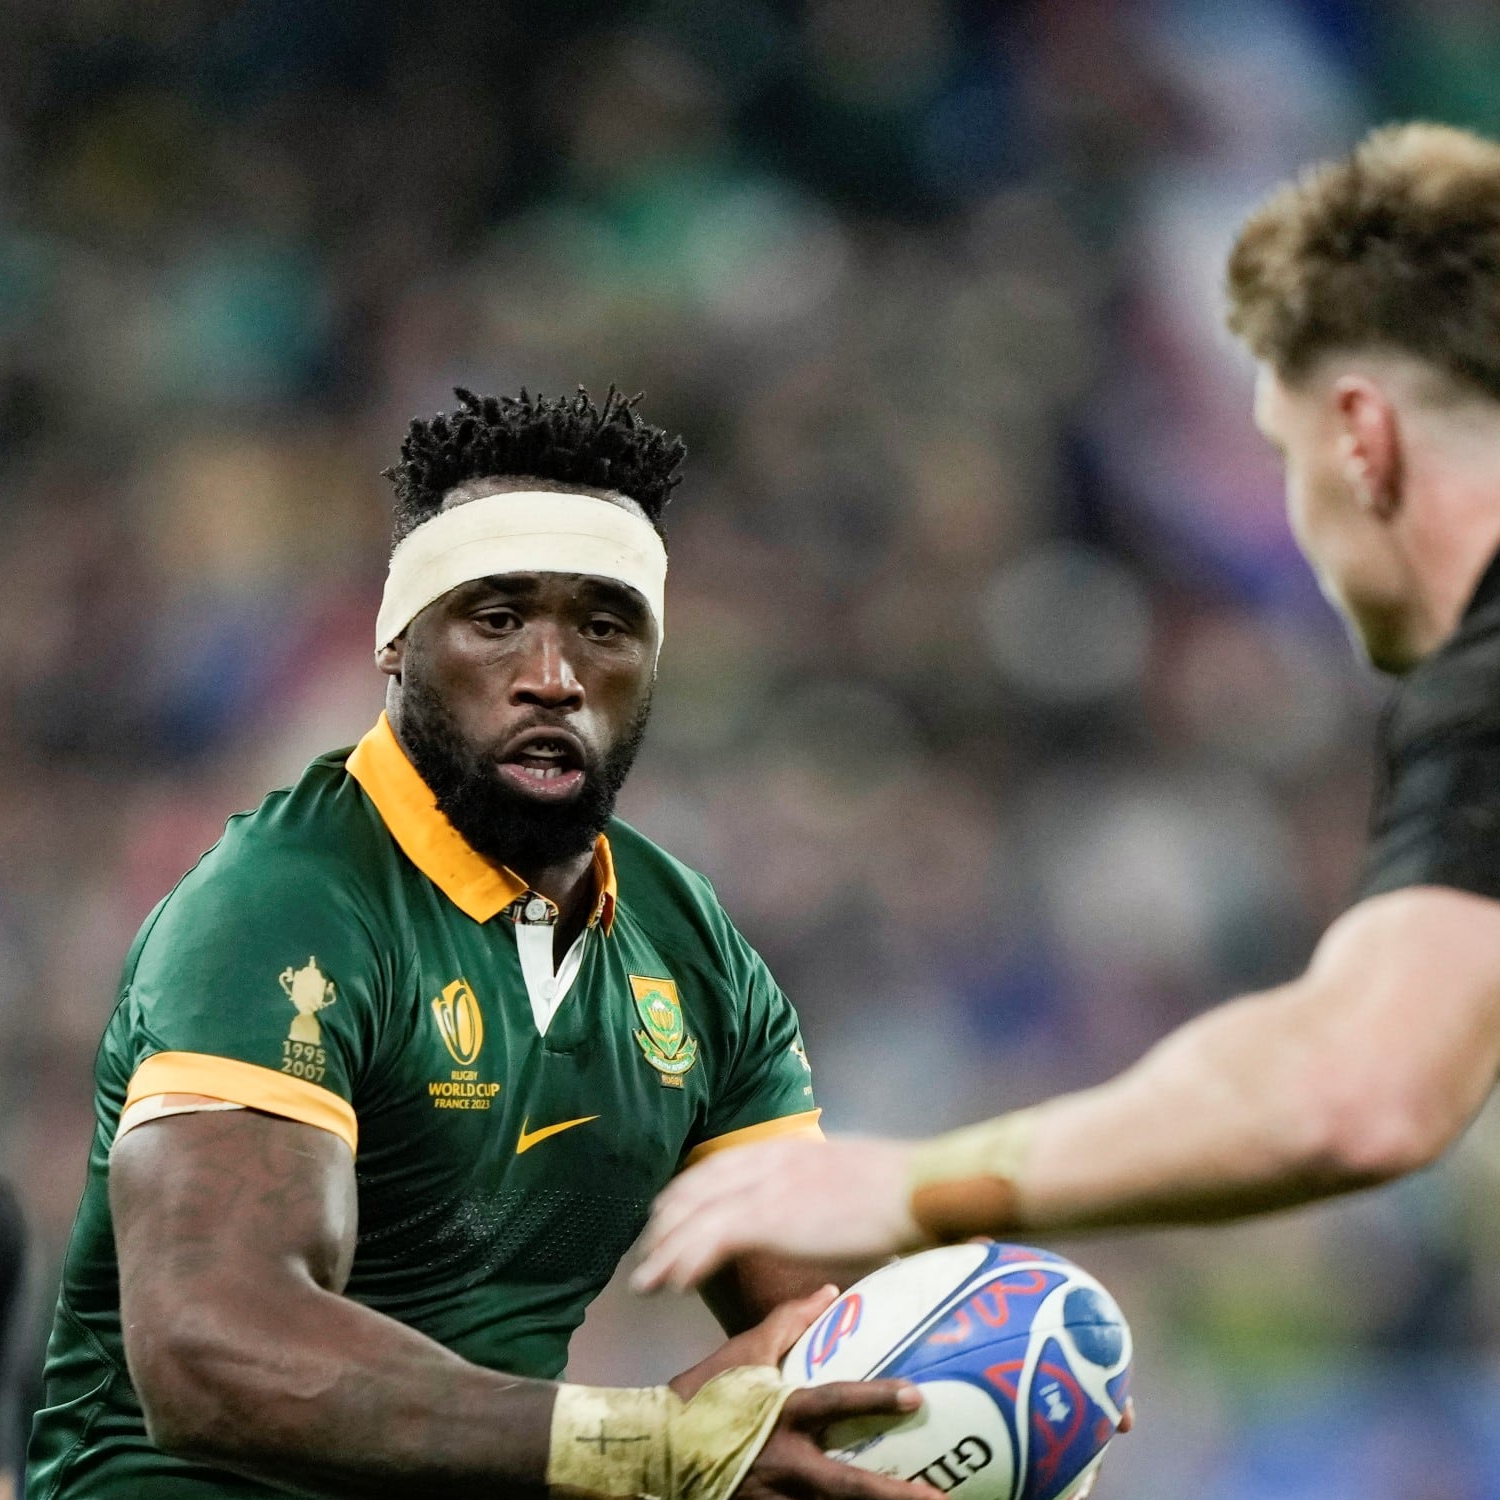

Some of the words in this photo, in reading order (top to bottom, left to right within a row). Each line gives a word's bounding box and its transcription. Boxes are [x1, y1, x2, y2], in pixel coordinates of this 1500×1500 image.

[283, 1040, 325, 1065] 1995
[281, 1057, 325, 1081] 2007
[451, 1070, 478, 1080] RUGBY
[428, 1083, 475, 1096] WORLD
[476, 1083, 500, 1096] CUP
[434, 1098, 469, 1109] FRANCE
[471, 1099, 490, 1109] 2023
